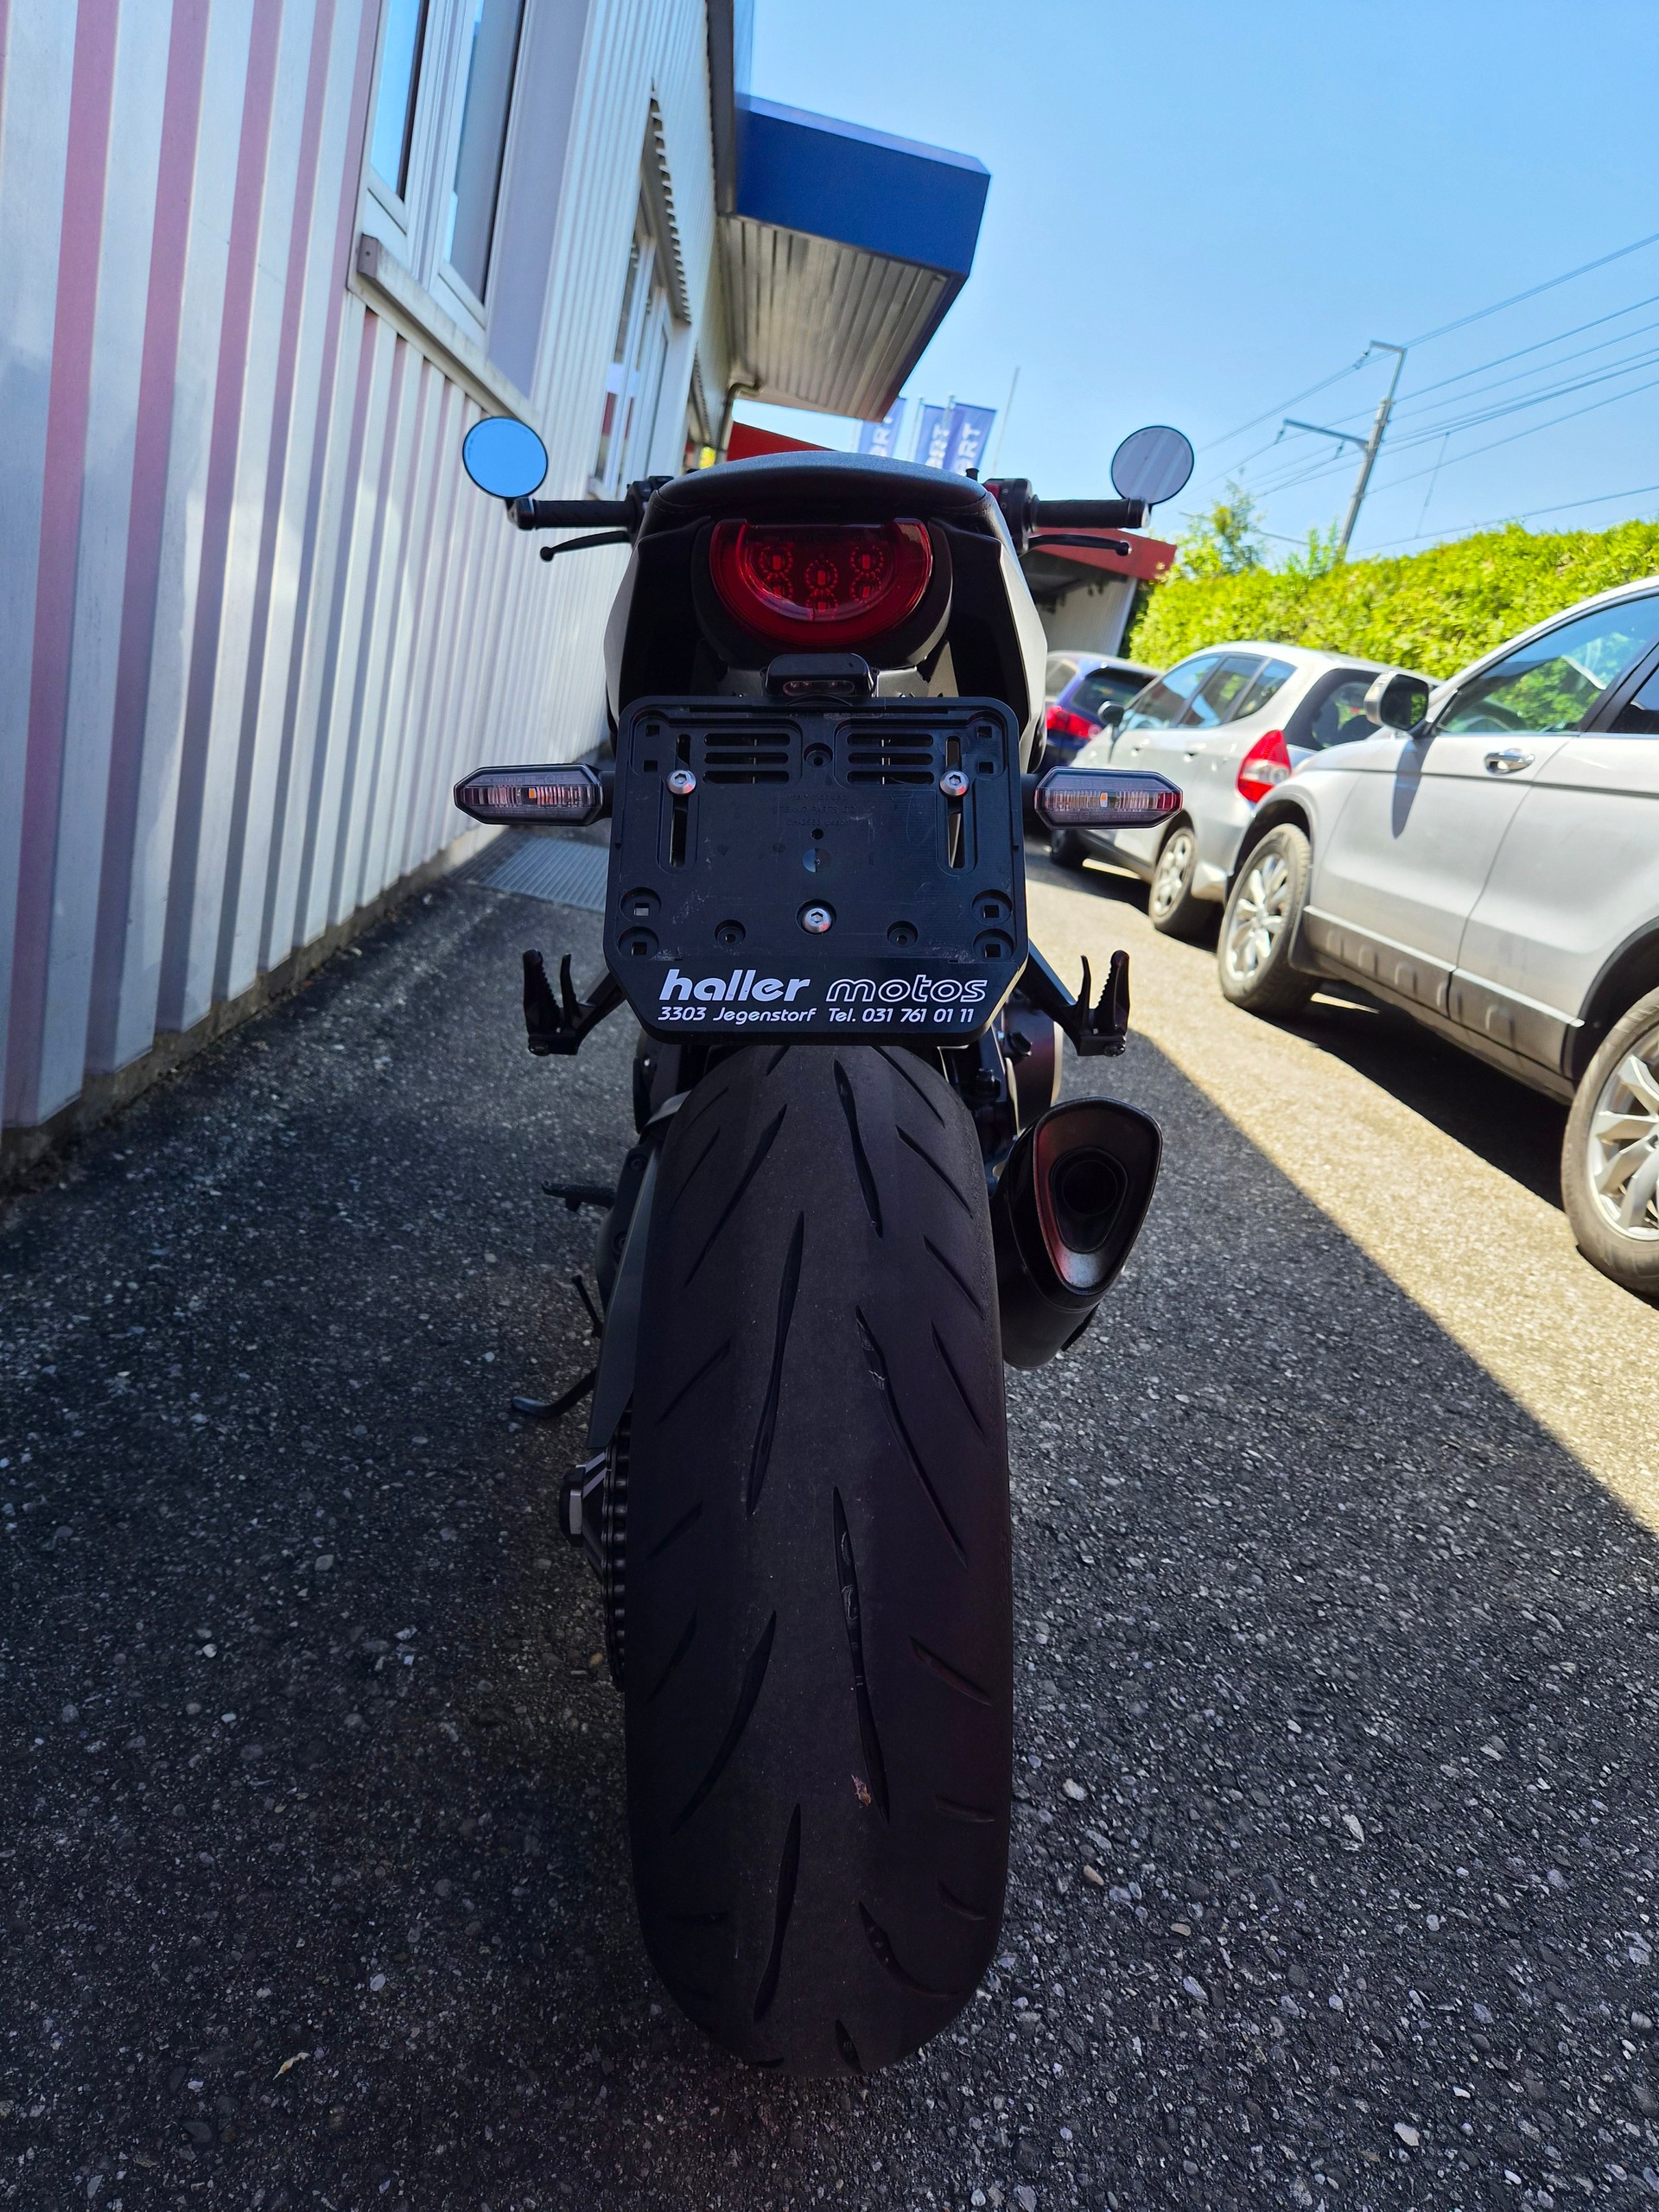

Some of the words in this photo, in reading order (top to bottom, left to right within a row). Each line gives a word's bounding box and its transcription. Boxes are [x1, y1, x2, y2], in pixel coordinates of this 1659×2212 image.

[658, 969, 810, 1001] haller
[826, 975, 988, 1002] motos
[658, 1007, 707, 1021] 3303
[712, 1007, 817, 1026] Jegenstorf
[829, 1007, 856, 1022] Tel.
[861, 1007, 894, 1023] 031
[899, 1007, 927, 1023] 761
[933, 1007, 954, 1023] 01
[960, 1008, 975, 1023] 11
